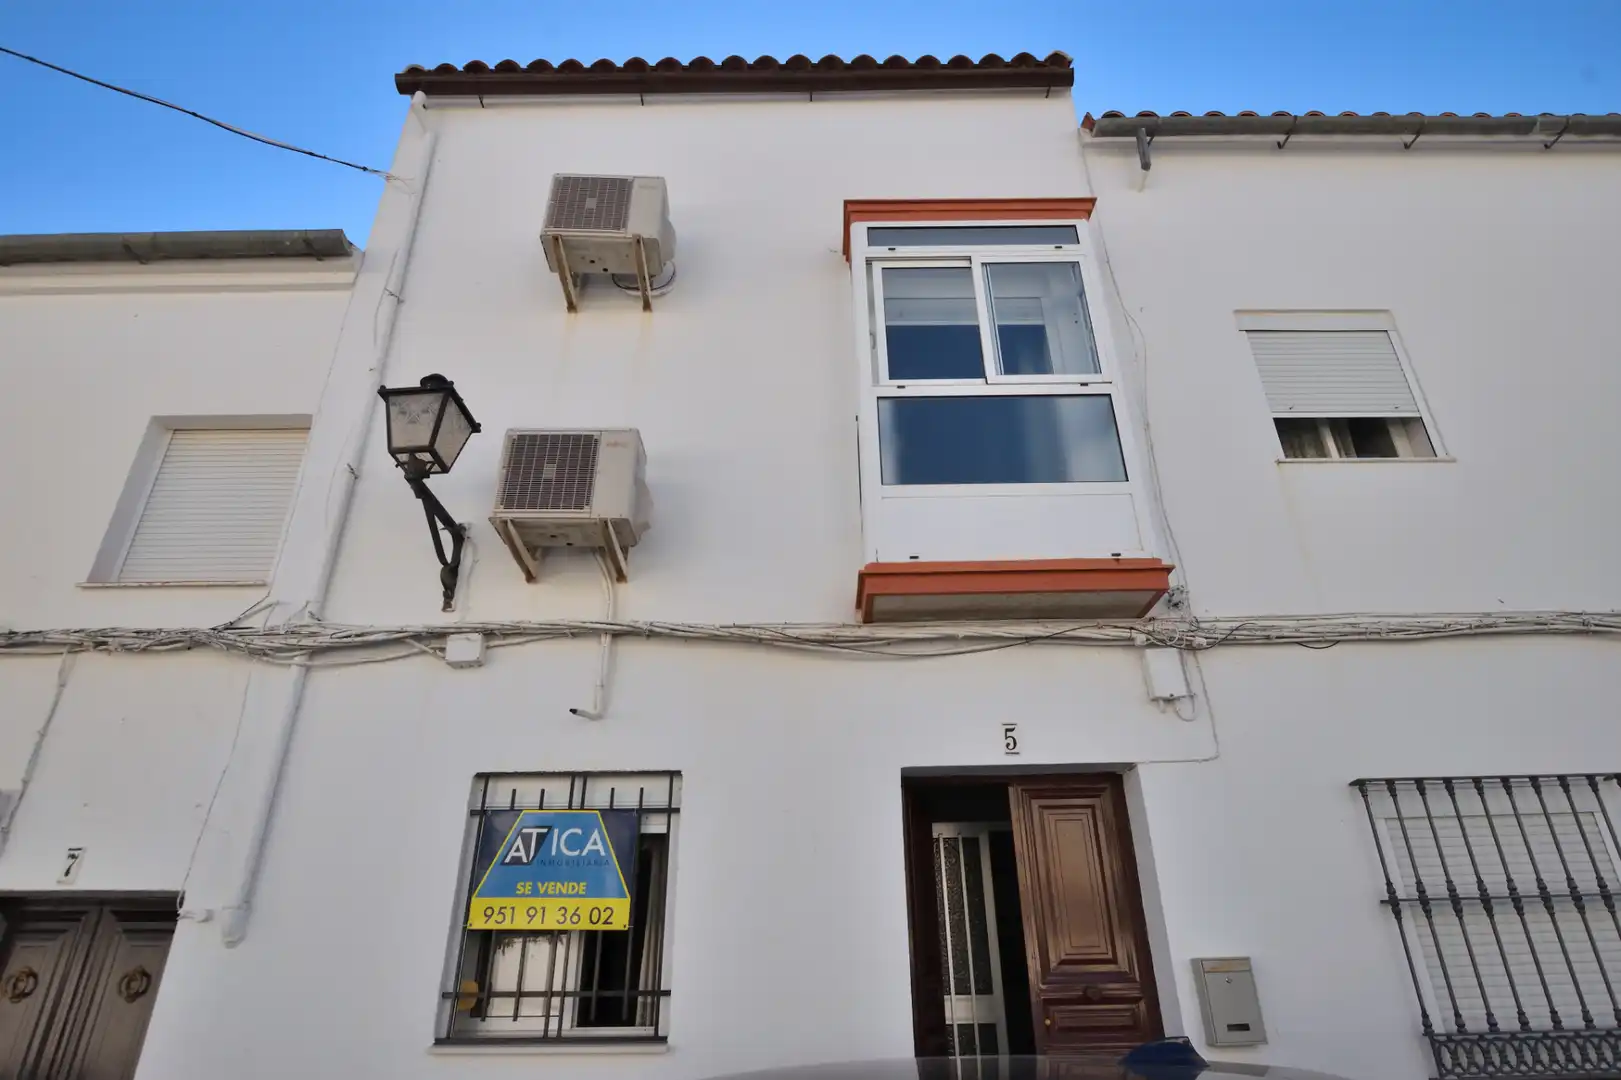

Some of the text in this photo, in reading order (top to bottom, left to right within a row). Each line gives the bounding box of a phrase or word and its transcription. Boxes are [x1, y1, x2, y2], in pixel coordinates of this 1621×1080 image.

[1004, 726, 1018, 751] 5
[63, 852, 80, 878] 7
[515, 882, 588, 895] SE VENDE
[483, 906, 615, 925] 951 91 36 02
